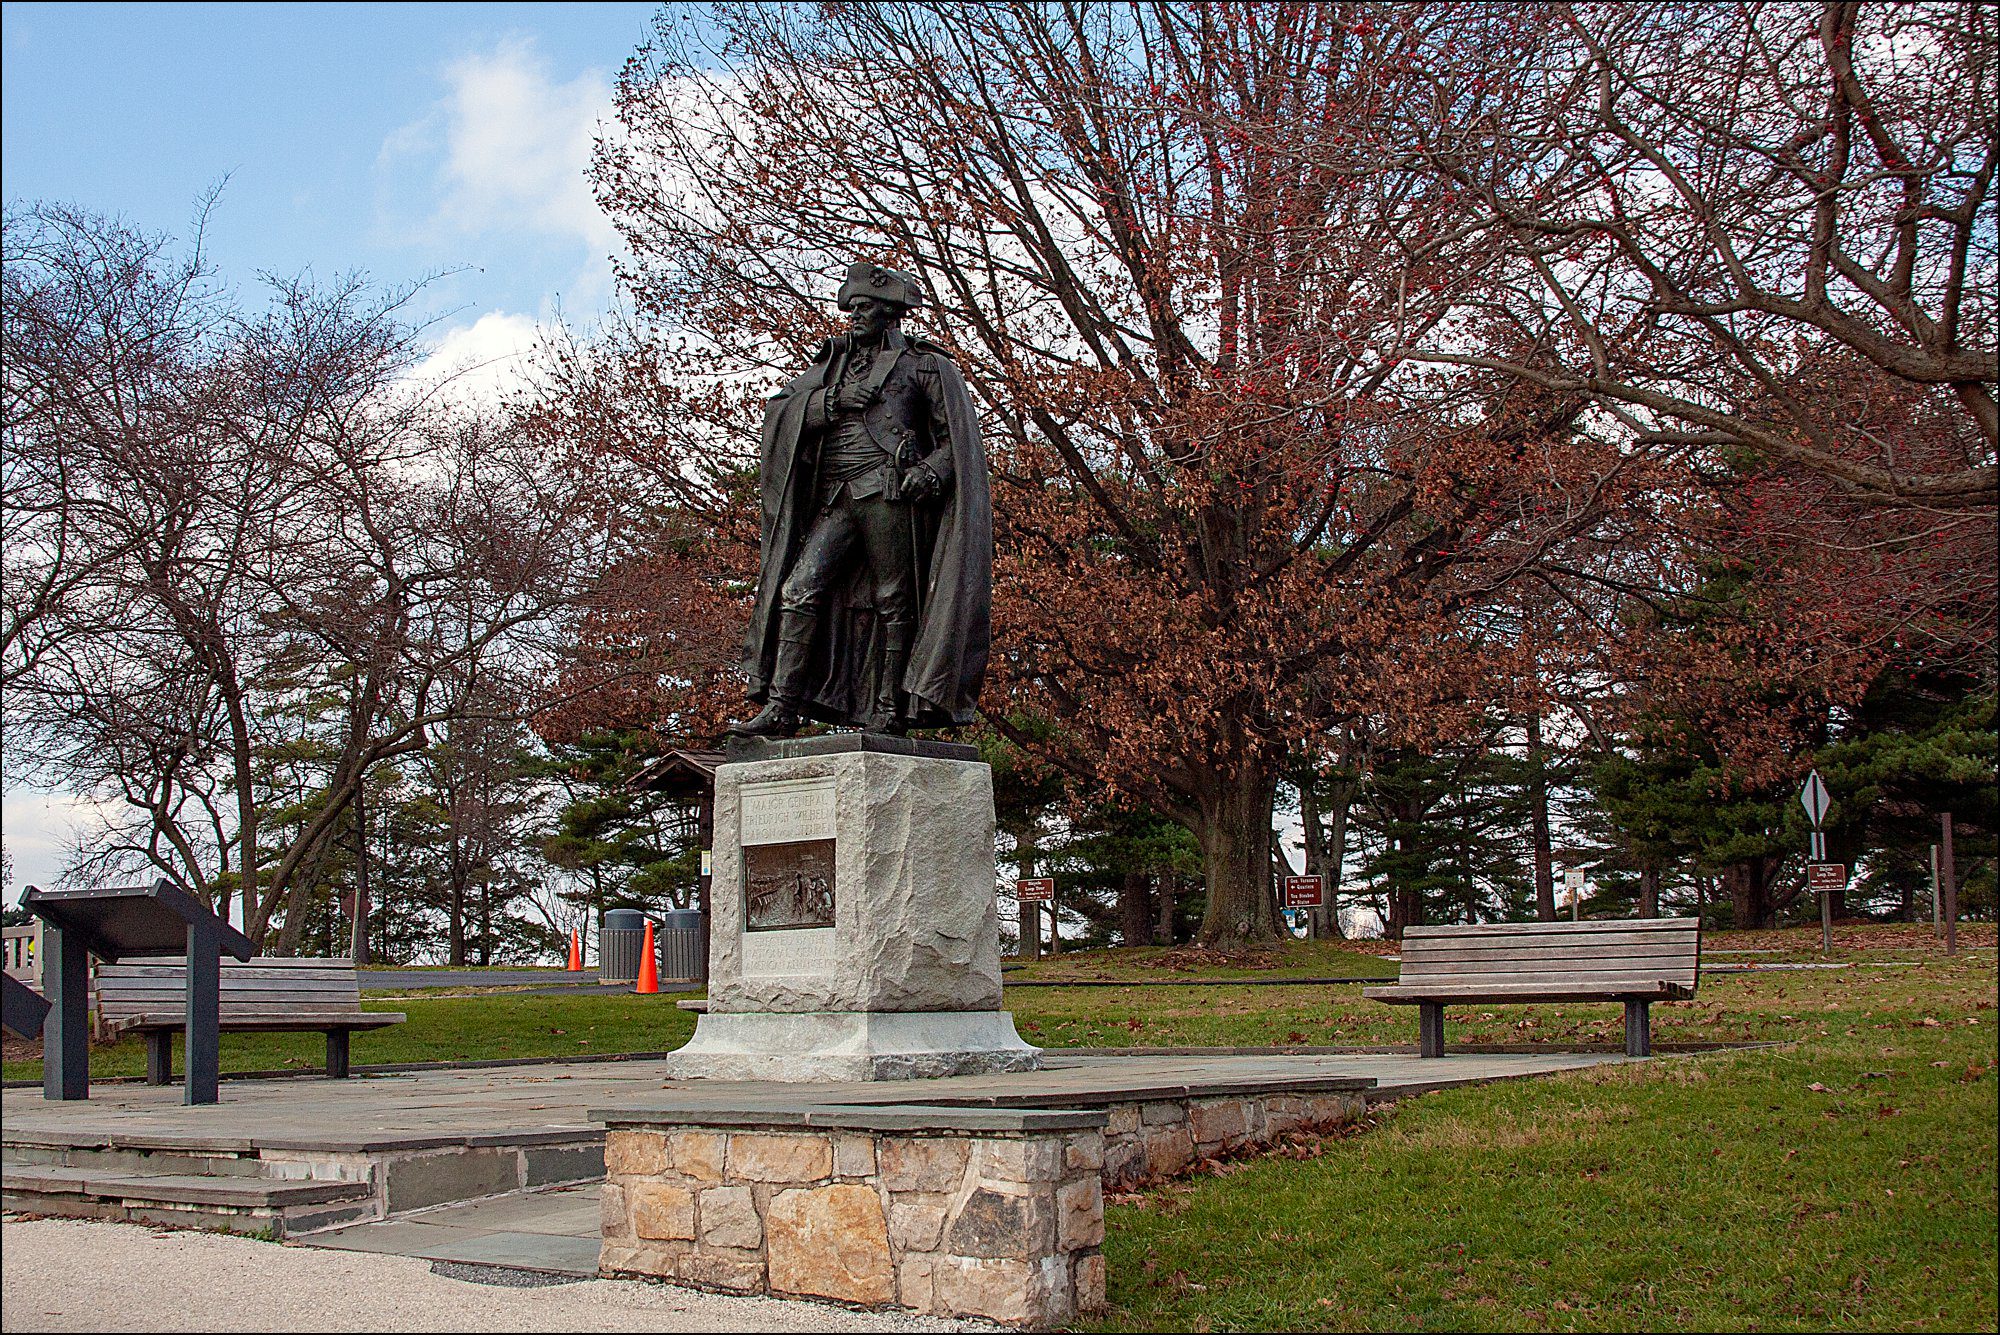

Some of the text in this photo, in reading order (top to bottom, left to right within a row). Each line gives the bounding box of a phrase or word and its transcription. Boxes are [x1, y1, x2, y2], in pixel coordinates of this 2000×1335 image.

[751, 794, 828, 812] MAJOR GENERAL
[744, 812, 790, 827] FRIEDRICH
[744, 828, 776, 841] BARON
